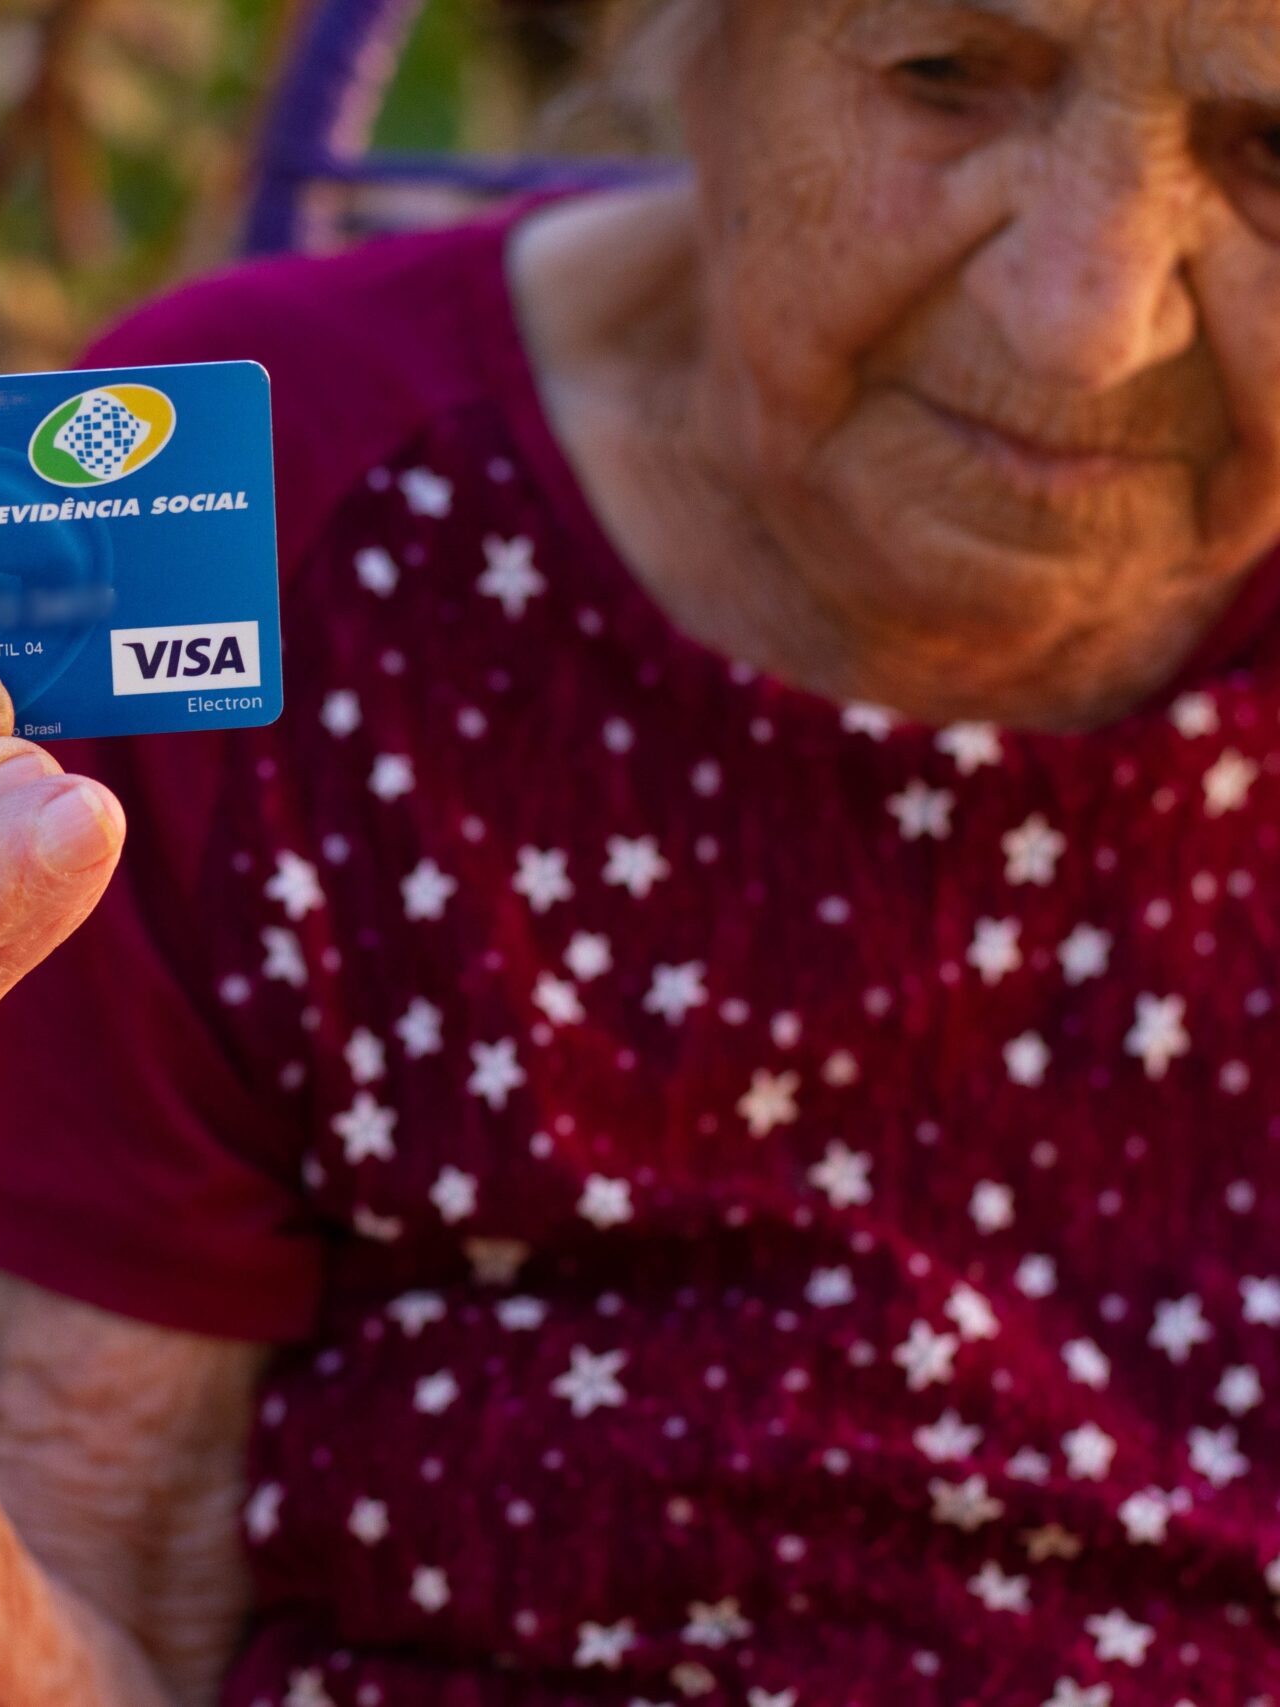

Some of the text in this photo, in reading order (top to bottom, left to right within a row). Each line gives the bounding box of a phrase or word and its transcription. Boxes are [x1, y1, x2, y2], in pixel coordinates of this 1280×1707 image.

[150, 491, 250, 515] SOCIAL
[25, 641, 43, 655] 04
[122, 636, 246, 679] VISA
[187, 696, 263, 713] Electron
[24, 722, 62, 736] Brasil
